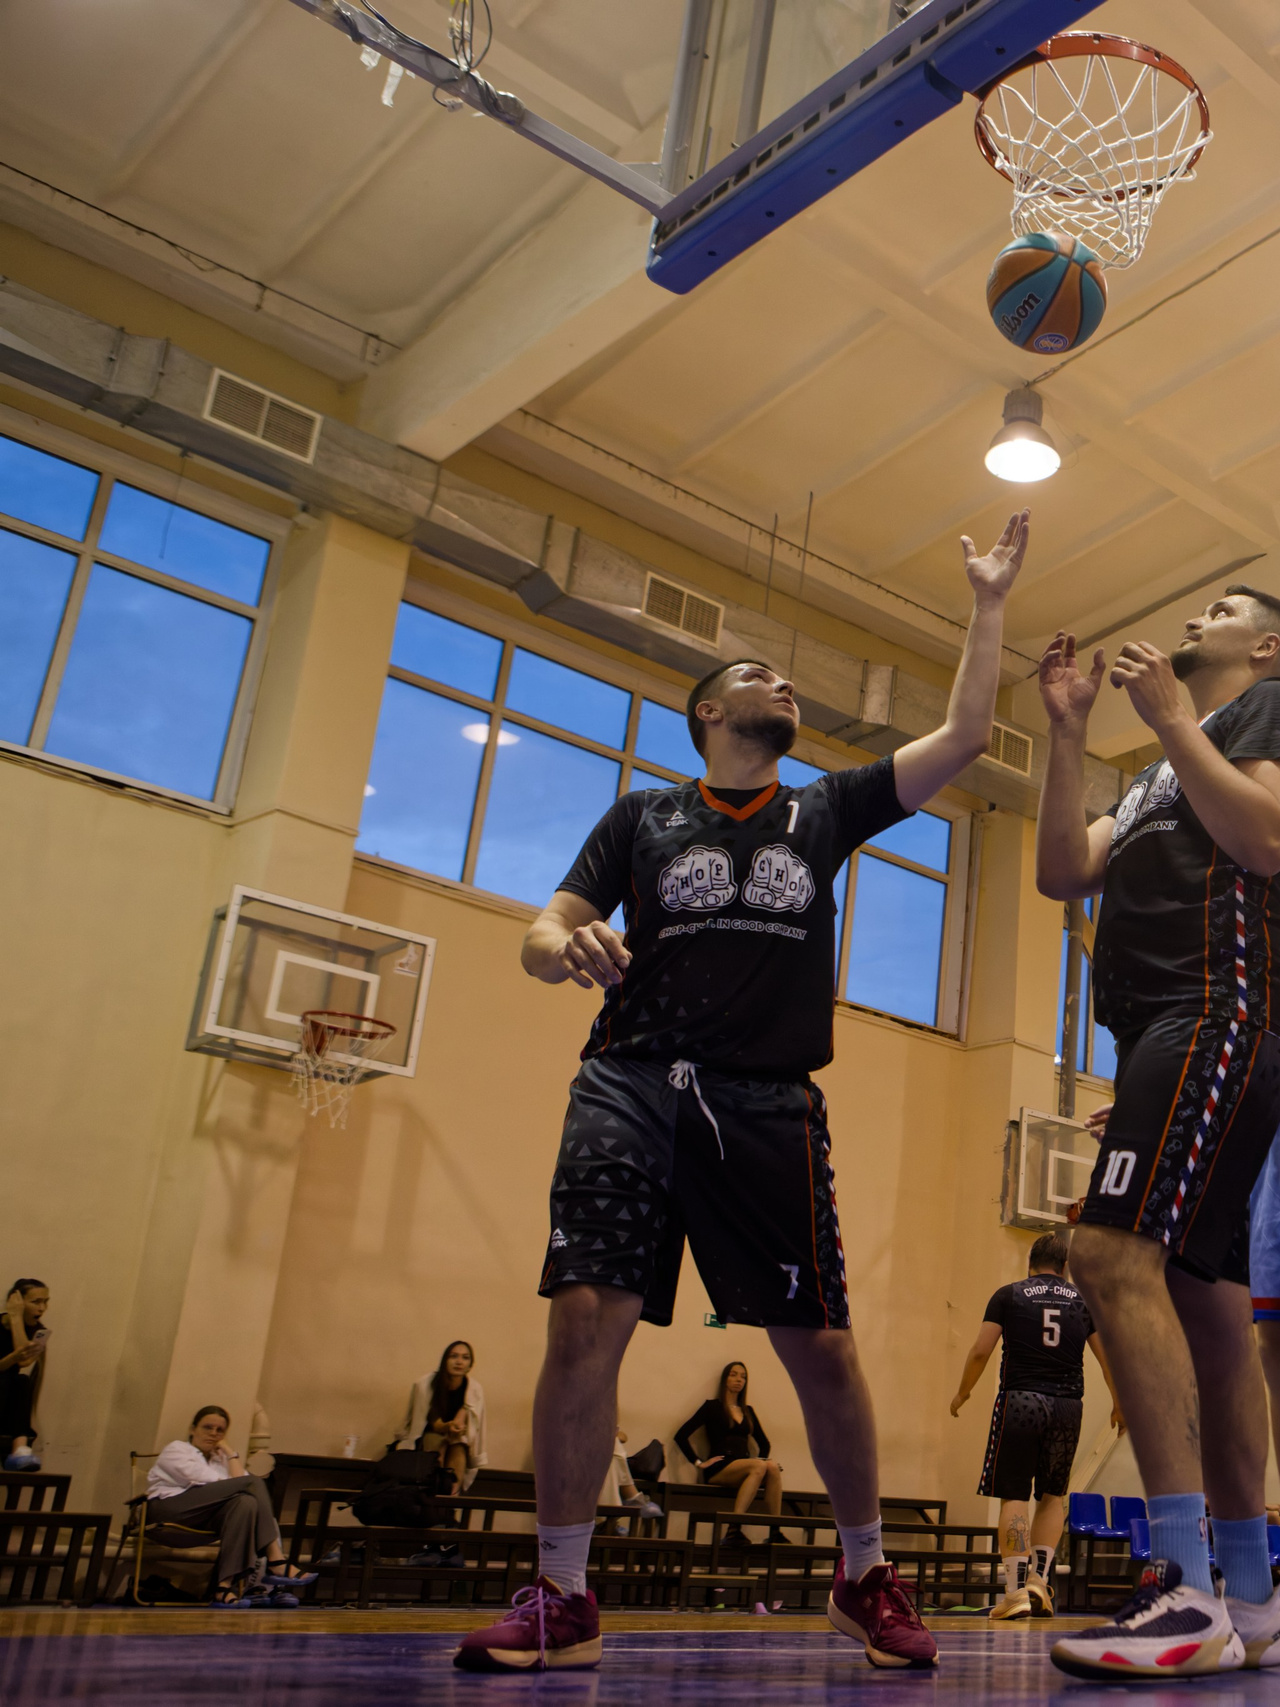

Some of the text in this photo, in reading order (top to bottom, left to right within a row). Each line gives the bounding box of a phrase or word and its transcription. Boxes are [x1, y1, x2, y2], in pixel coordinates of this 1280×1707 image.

[1000, 291, 1042, 338] ilson
[666, 818, 689, 828] PEAK
[786, 800, 800, 833] 1
[717, 918, 730, 929] IN
[731, 919, 765, 932] GOOD
[765, 923, 808, 940] COMPANY
[1100, 1150, 1137, 1196] 10
[1023, 1285, 1078, 1299] CHOP-CHOP
[1042, 1308, 1061, 1347] 5
